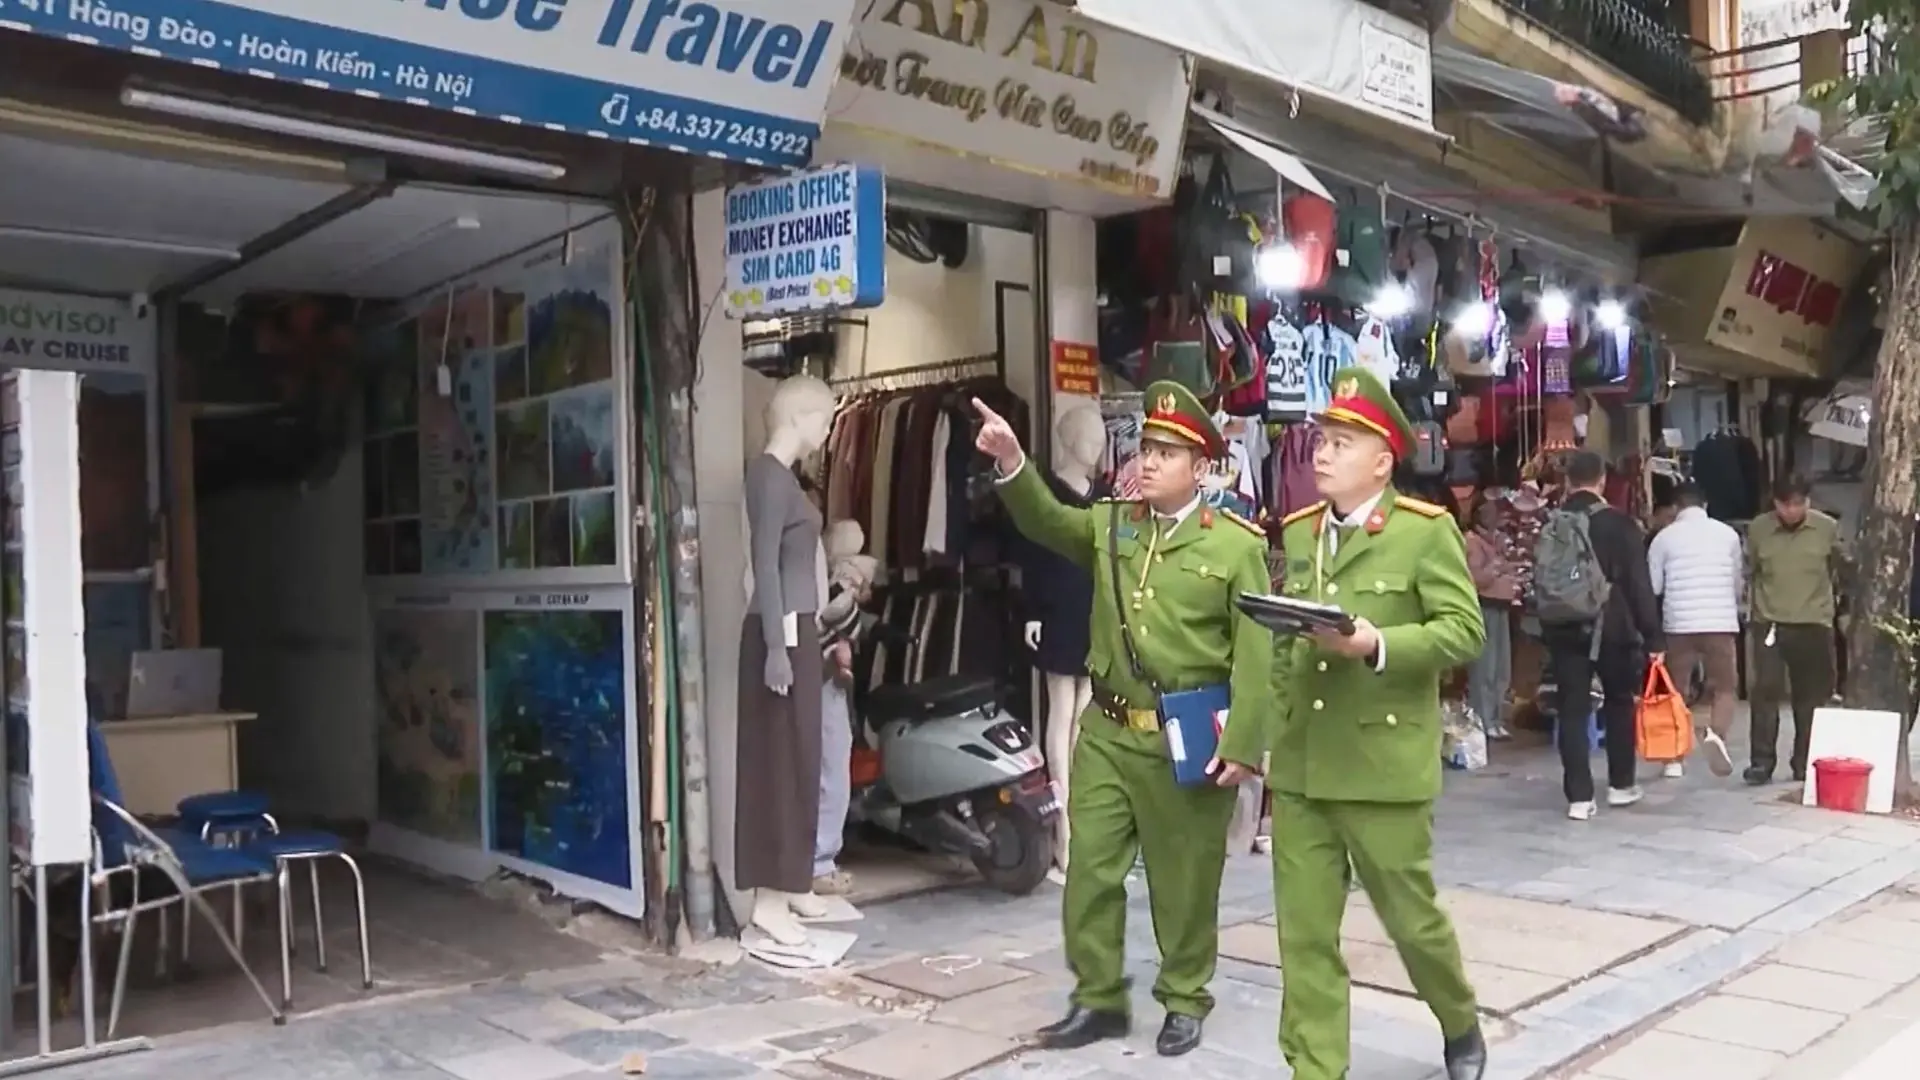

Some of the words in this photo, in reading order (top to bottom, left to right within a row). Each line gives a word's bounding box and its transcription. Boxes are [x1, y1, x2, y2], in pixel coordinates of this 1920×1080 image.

[68, 0, 149, 41] Hàng
[159, 16, 216, 48] Đào
[239, 32, 308, 67] Hoàn
[315, 48, 375, 79] Kiếm
[396, 64, 428, 89] Hà
[435, 72, 474, 101] Nội
[596, 0, 834, 88] Travel
[1000, 4, 1099, 83] An
[895, 51, 987, 122] Trang
[1051, 93, 1103, 143] Cao
[1108, 110, 1159, 167] Cấp
[729, 182, 794, 224] BOOKING
[799, 170, 851, 211] OFFICE
[728, 223, 775, 256] MONEY
[778, 209, 852, 247] EXCHANGE
[741, 254, 770, 285] SIM
[774, 247, 816, 280] CARD
[820, 243, 841, 272] 4G
[43, 340, 130, 363] CRUISE
[1277, 356, 1298, 389] 28
[1318, 353, 1338, 388] 10
